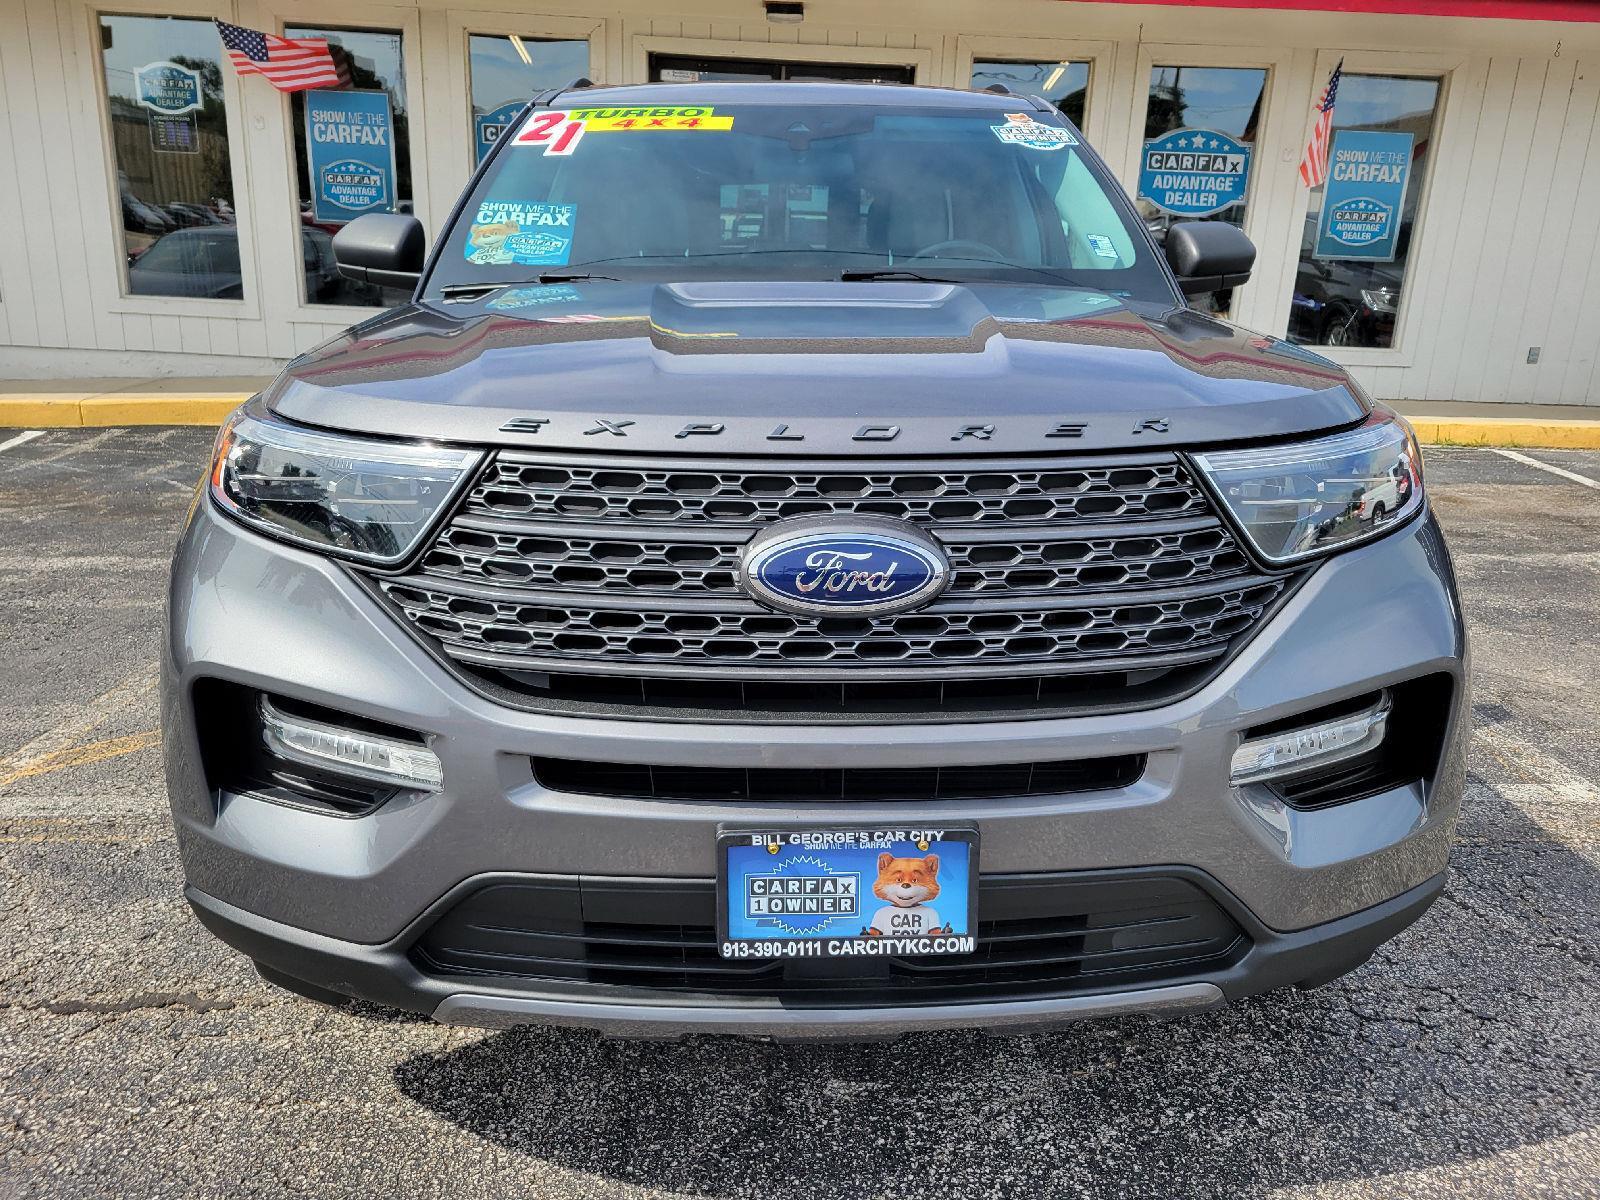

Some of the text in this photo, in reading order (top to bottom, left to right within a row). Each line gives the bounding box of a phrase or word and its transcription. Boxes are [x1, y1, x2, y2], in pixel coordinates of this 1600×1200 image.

[144, 79, 193, 89] CARFAX
[148, 89, 191, 99] ADVANTAGE
[156, 98, 185, 107] DEALER
[312, 110, 385, 126] SHOW ME THE
[576, 108, 706, 119] TURBO
[314, 124, 387, 146] CARFAX
[1149, 154, 1243, 174] CARFAX
[1336, 149, 1406, 164] SHOW ME THE
[1333, 162, 1406, 183] CARFAX
[327, 175, 380, 186] CARFAX
[1152, 174, 1234, 191] ADVANTAGE
[331, 186, 377, 196] ADVANTAGE
[340, 195, 370, 205] DEALER
[1164, 191, 1218, 207] DEALER
[479, 202, 571, 215] SHOW ME THE
[476, 211, 573, 226] CARFAX
[1335, 212, 1385, 223] CARFAX
[1336, 222, 1380, 232] ADVANTAGE
[1342, 231, 1371, 240] DEALER
[498, 416, 1169, 442] EXPLORER
[796, 550, 898, 592] Ford
[752, 830, 945, 846] BILL GEORGE'S CAR CITY
[804, 842, 829, 850] SHOW
[859, 840, 892, 850] CARFAX
[752, 879, 855, 896] CARFAX
[753, 897, 854, 913] 1 OWNER
[891, 913, 922, 928] CAR
[723, 937, 974, 957] 913-390-0111 CARCITYKC.COM
